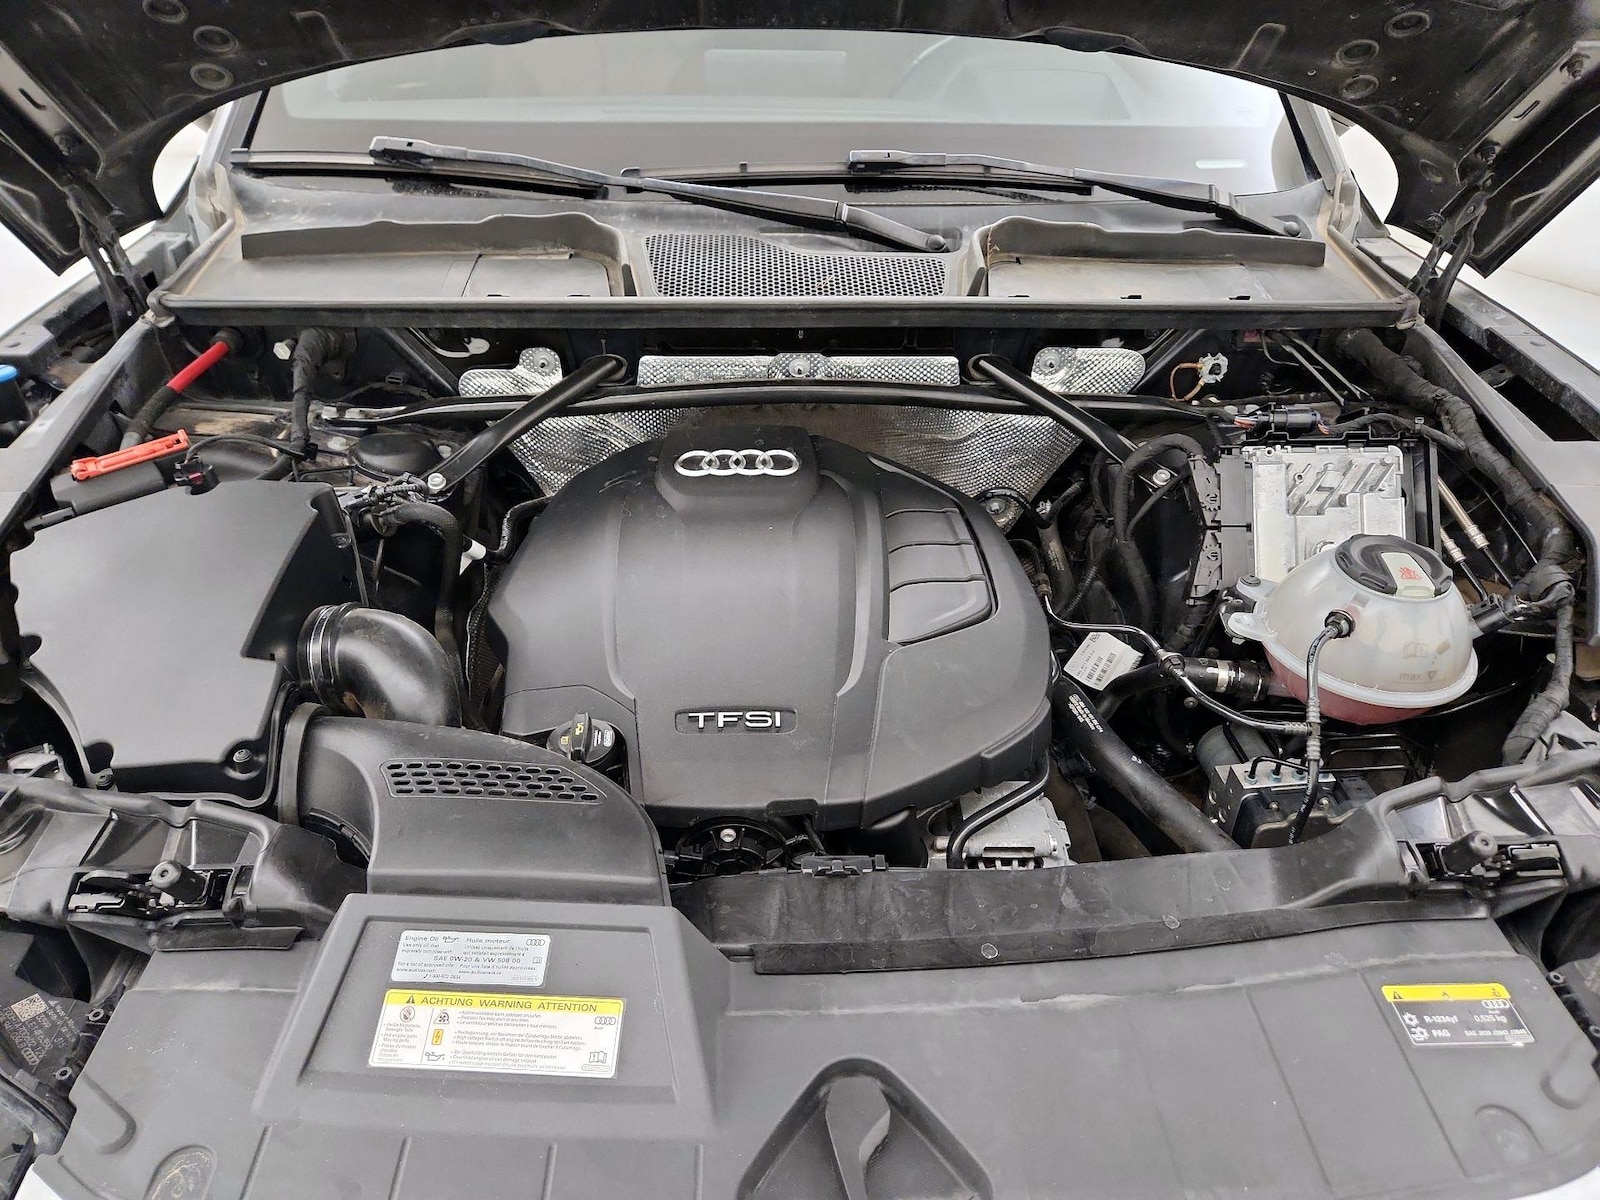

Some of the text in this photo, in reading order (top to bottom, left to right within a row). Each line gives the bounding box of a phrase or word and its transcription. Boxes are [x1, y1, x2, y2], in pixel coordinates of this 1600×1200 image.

[688, 710, 781, 729] TFSI
[405, 935, 428, 943] Engine
[420, 997, 598, 1013] ACHTUNG WARNING ATTENTION
[1423, 1015, 1459, 1024] R-1234yf
[1495, 1015, 1508, 1024] kg
[1431, 1029, 1451, 1038] PAG
